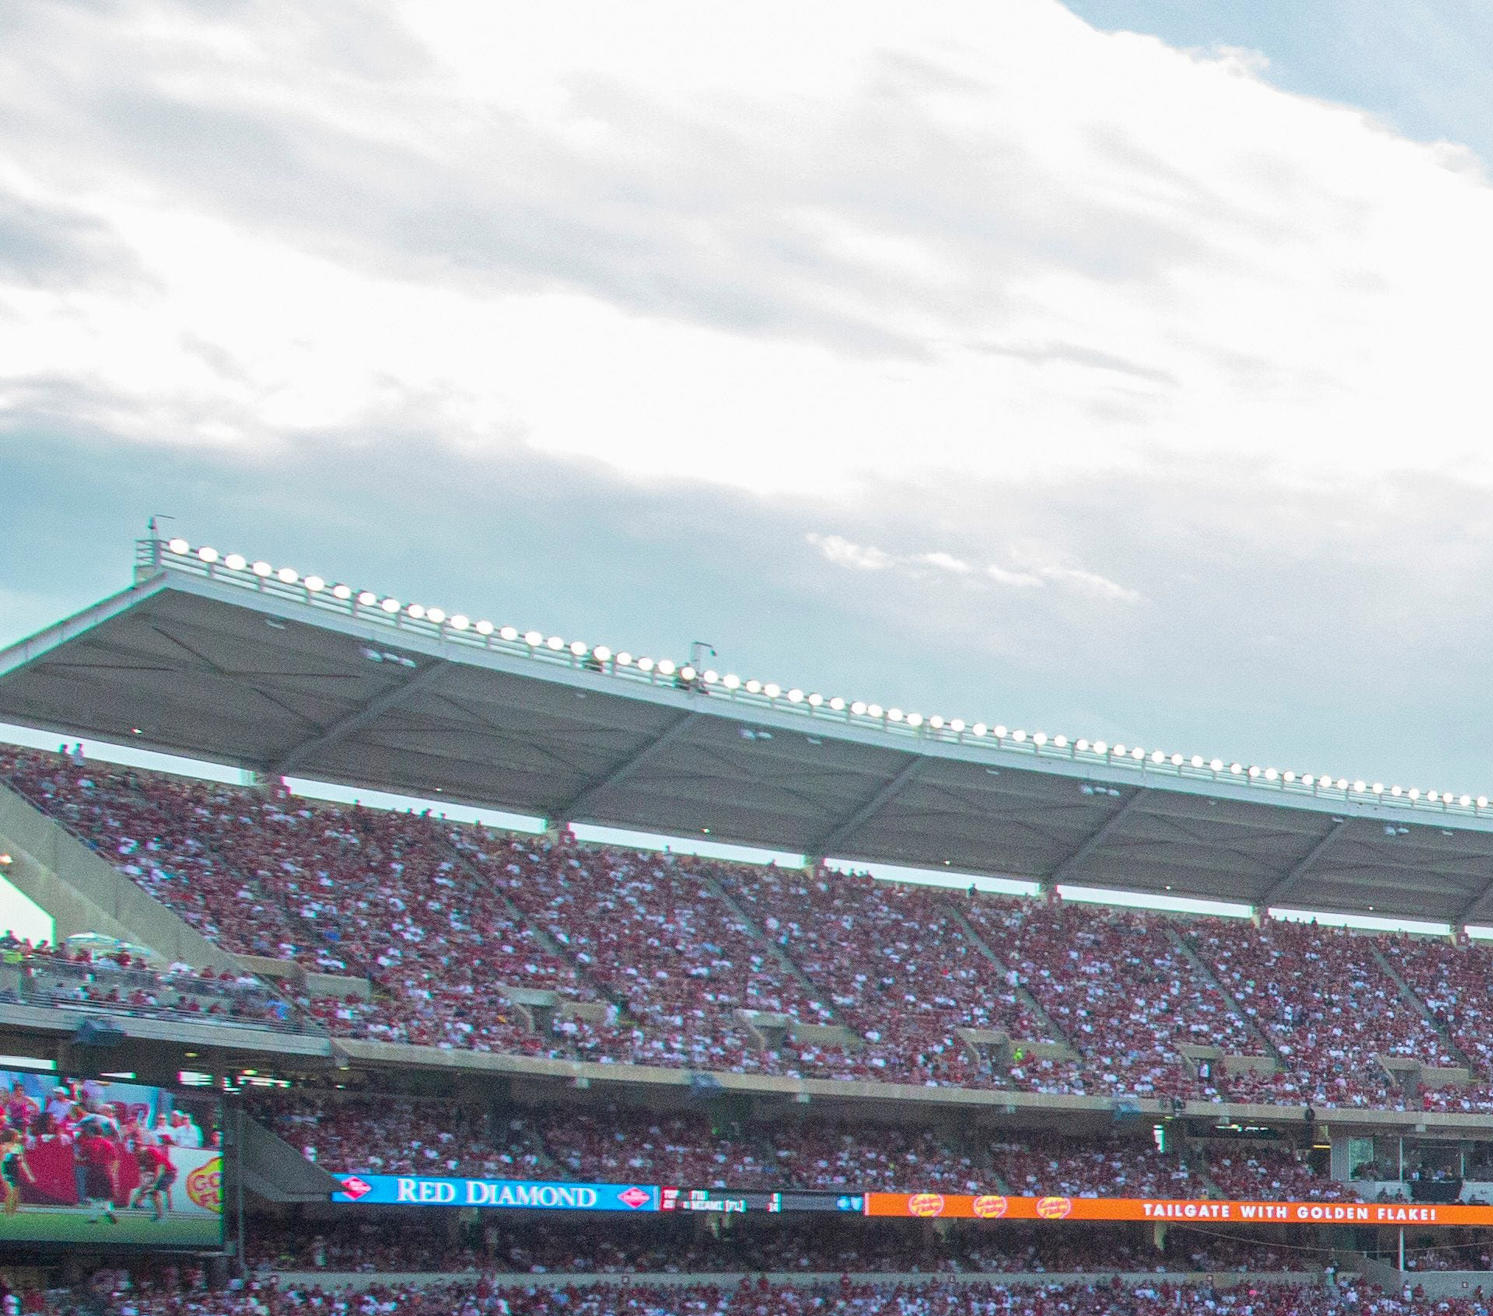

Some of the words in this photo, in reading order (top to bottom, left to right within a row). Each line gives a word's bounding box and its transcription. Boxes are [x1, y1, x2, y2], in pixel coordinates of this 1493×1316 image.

[396, 1178, 456, 1203] RED
[466, 1180, 597, 1207] DIAMOND
[1143, 1203, 1230, 1218] TAILGATE
[1240, 1205, 1288, 1219] WITH
[1297, 1206, 1368, 1220] GOLDEN
[1377, 1208, 1436, 1221] FLAKE!
